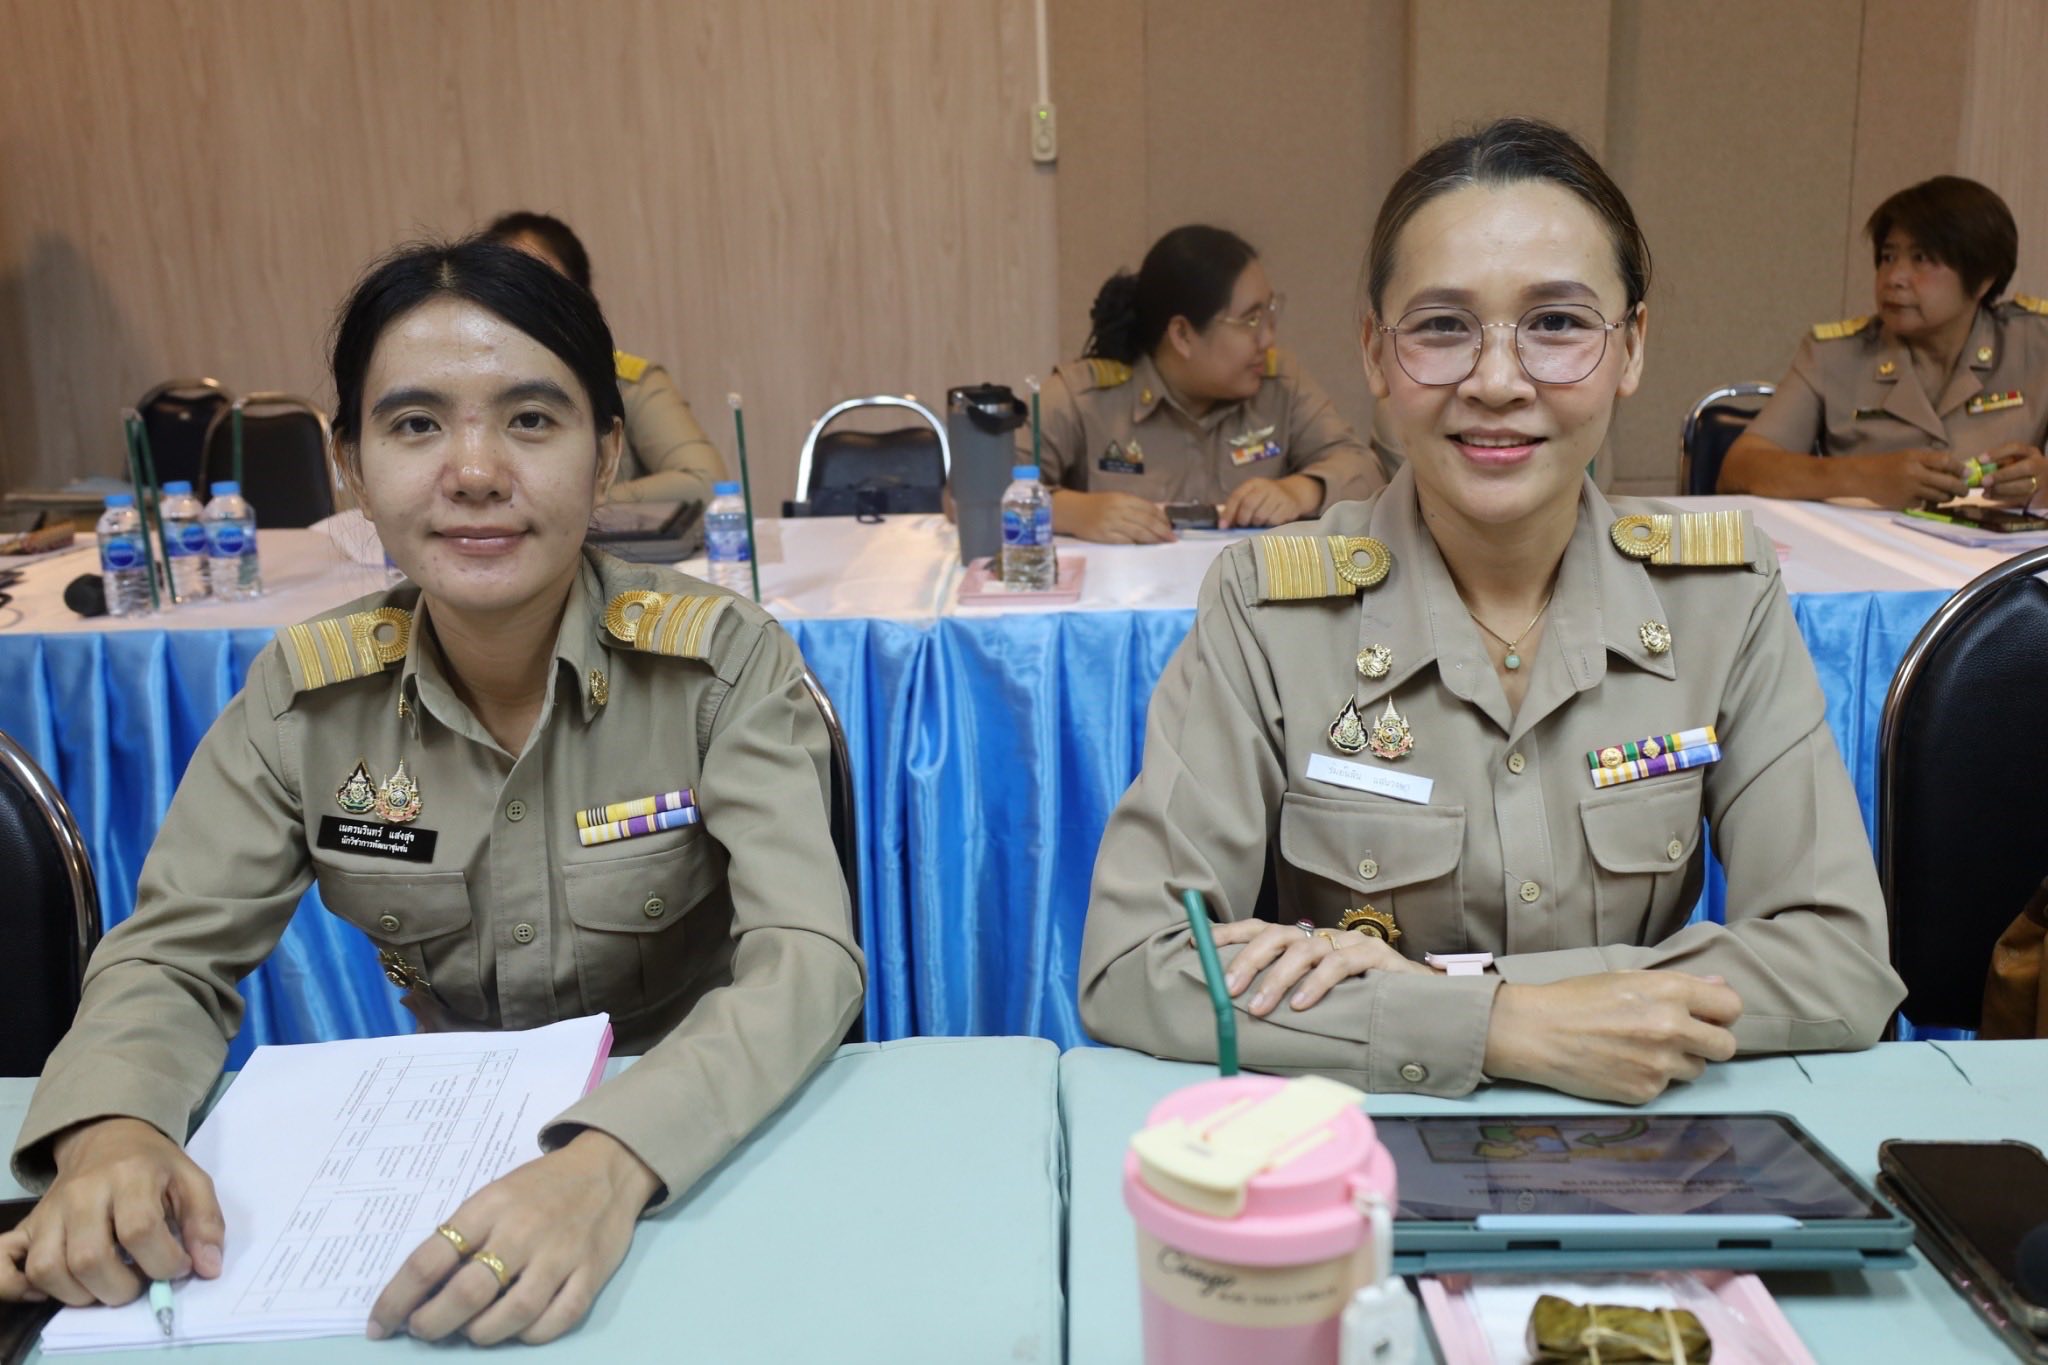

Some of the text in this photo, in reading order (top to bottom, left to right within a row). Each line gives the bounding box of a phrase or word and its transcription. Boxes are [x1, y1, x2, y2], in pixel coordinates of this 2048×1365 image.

[341, 835, 408, 853] นักวิชาการพัฒนาชุมชน
